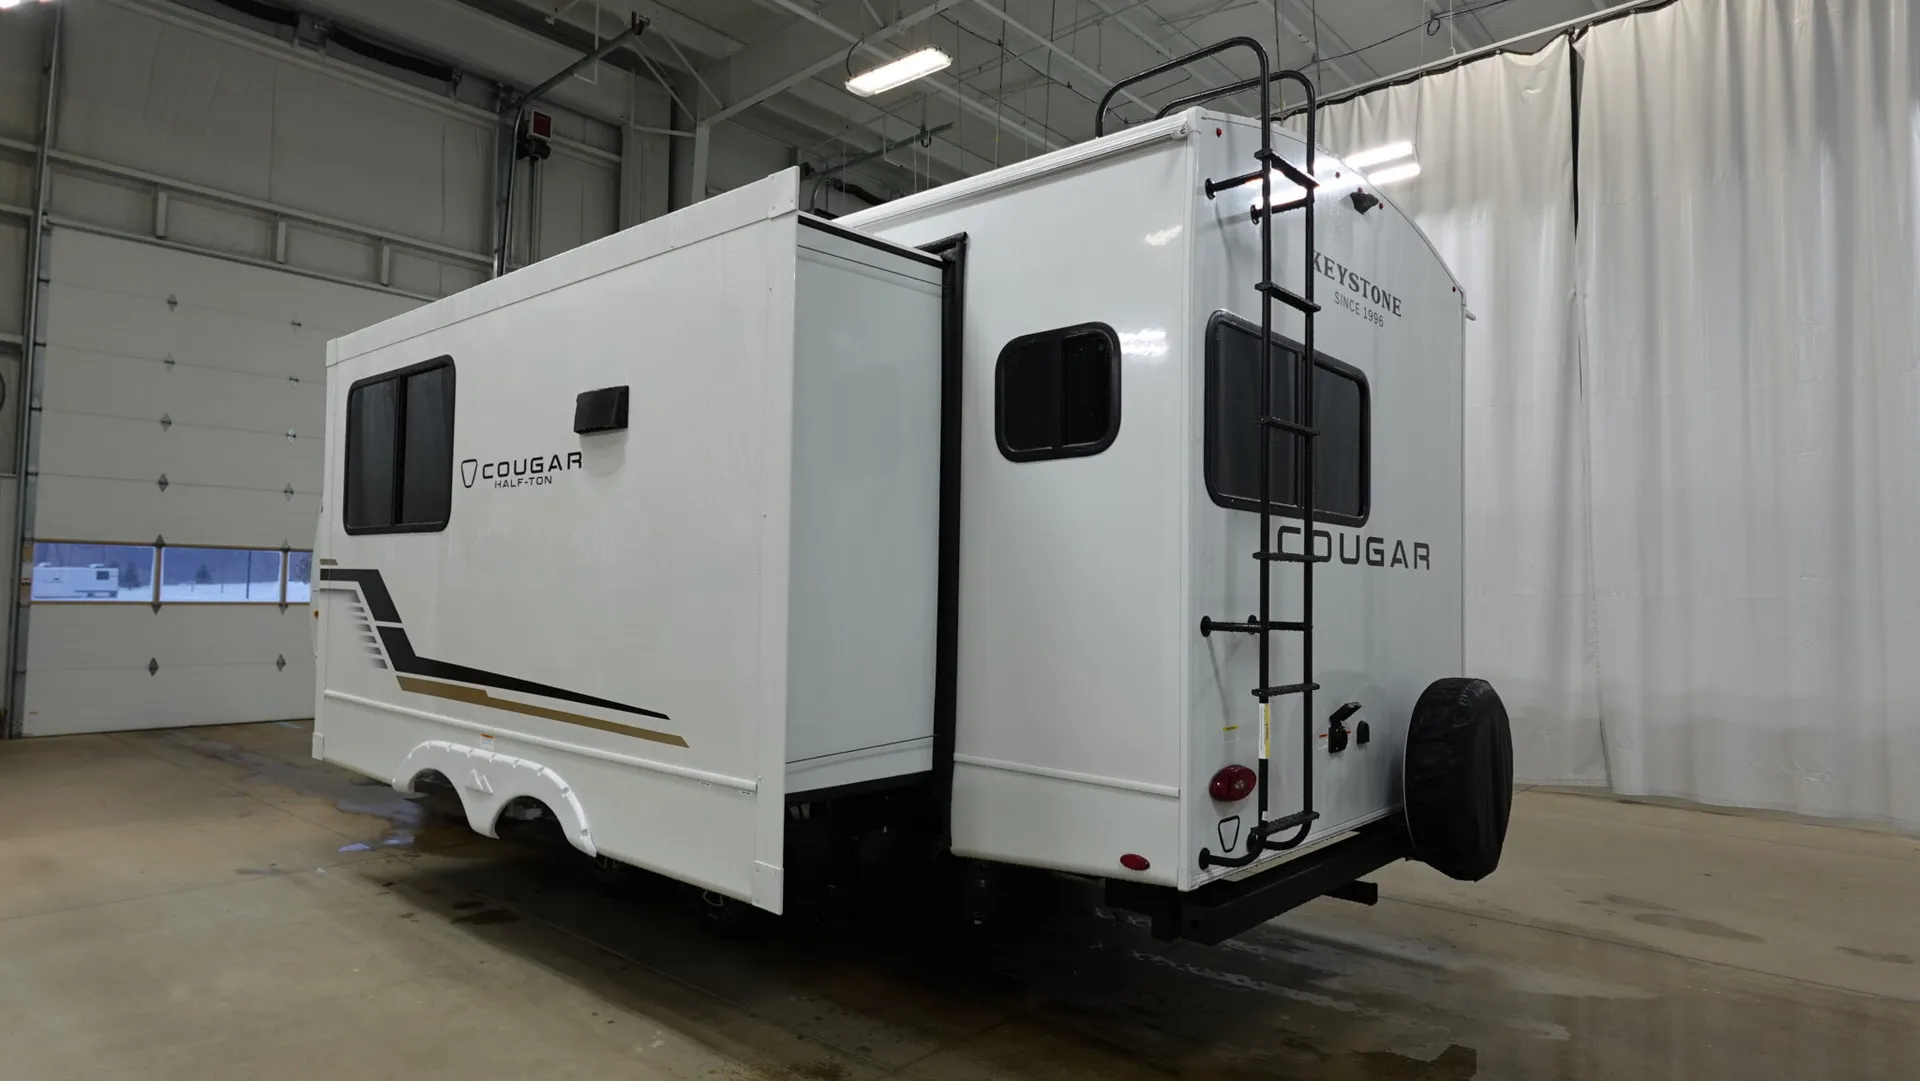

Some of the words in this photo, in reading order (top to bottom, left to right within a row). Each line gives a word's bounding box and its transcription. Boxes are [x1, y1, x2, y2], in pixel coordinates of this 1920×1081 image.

[1313, 250, 1402, 318] KEYSTONE
[1334, 291, 1360, 316] SINCE
[1363, 307, 1384, 328] 1996
[481, 451, 582, 480] COUGAR
[494, 475, 553, 489] HALF-TON
[1278, 525, 1430, 571] COUGAR
